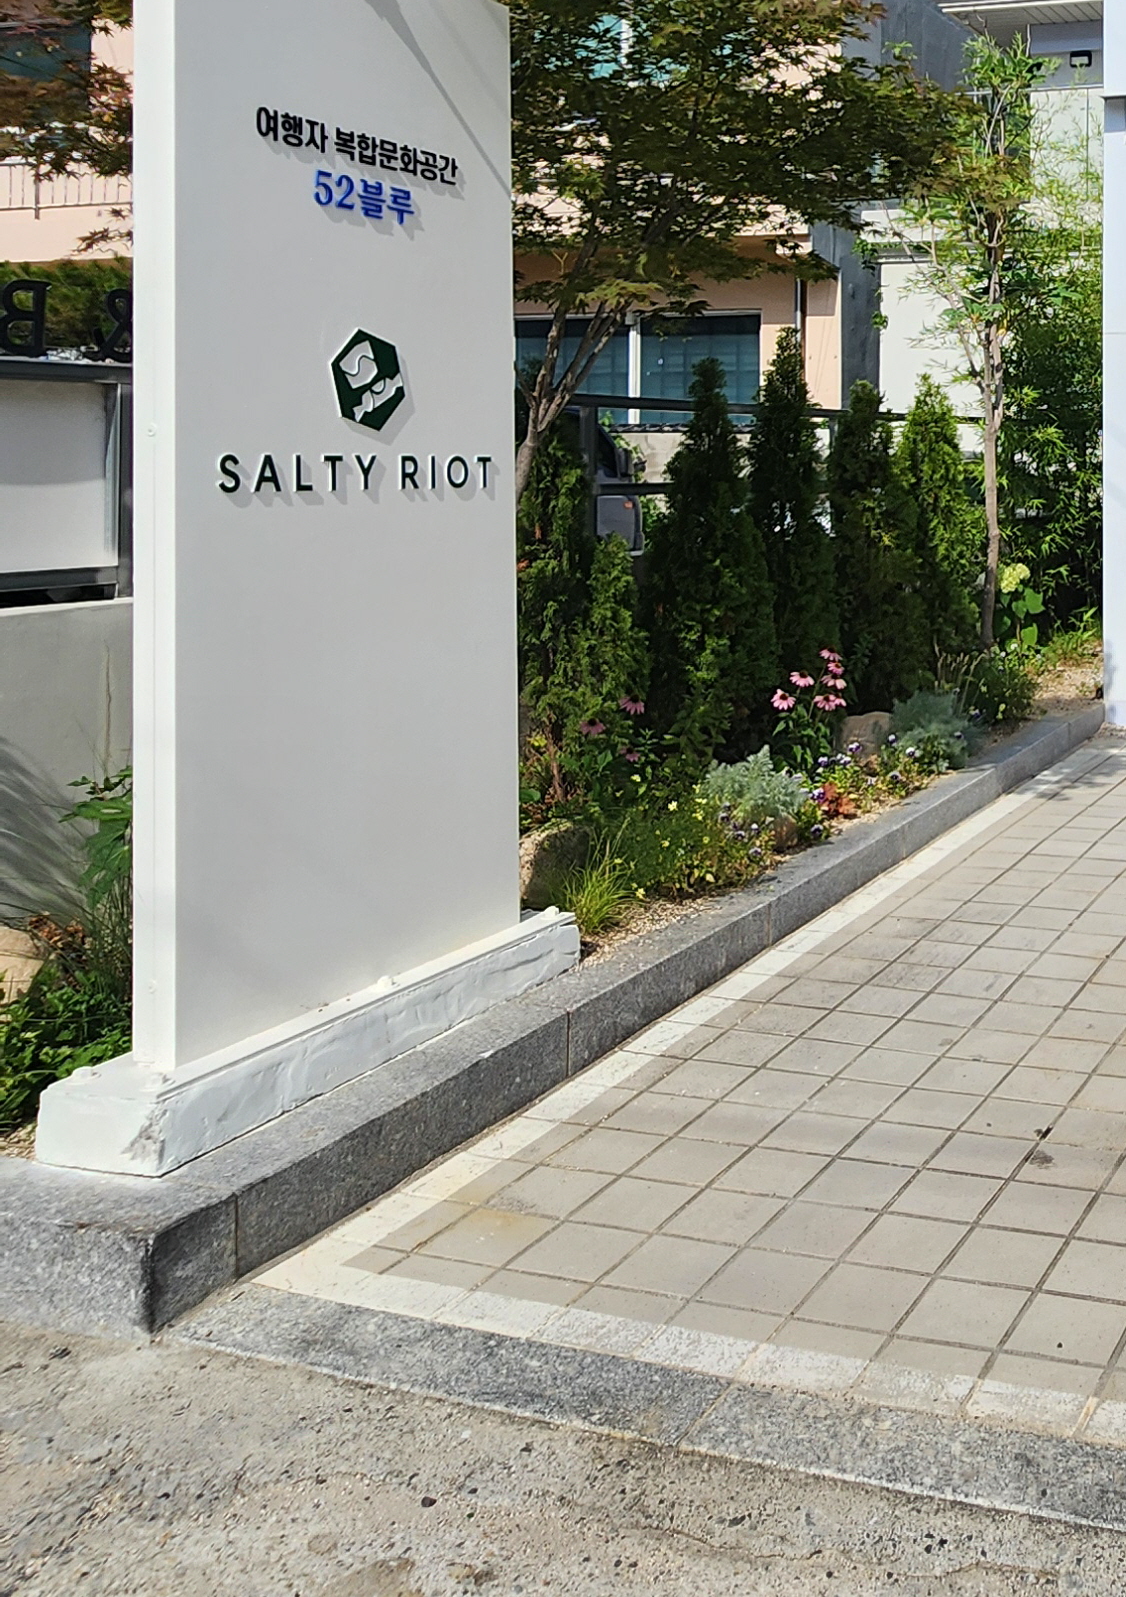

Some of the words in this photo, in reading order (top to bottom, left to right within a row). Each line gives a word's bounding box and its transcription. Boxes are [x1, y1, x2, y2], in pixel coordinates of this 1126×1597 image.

[256, 106, 328, 154] 여행자
[333, 126, 459, 186] 복합문화공간
[313, 169, 415, 225] 52블루
[217, 453, 378, 494] SALTY
[399, 454, 493, 491] RIOT
